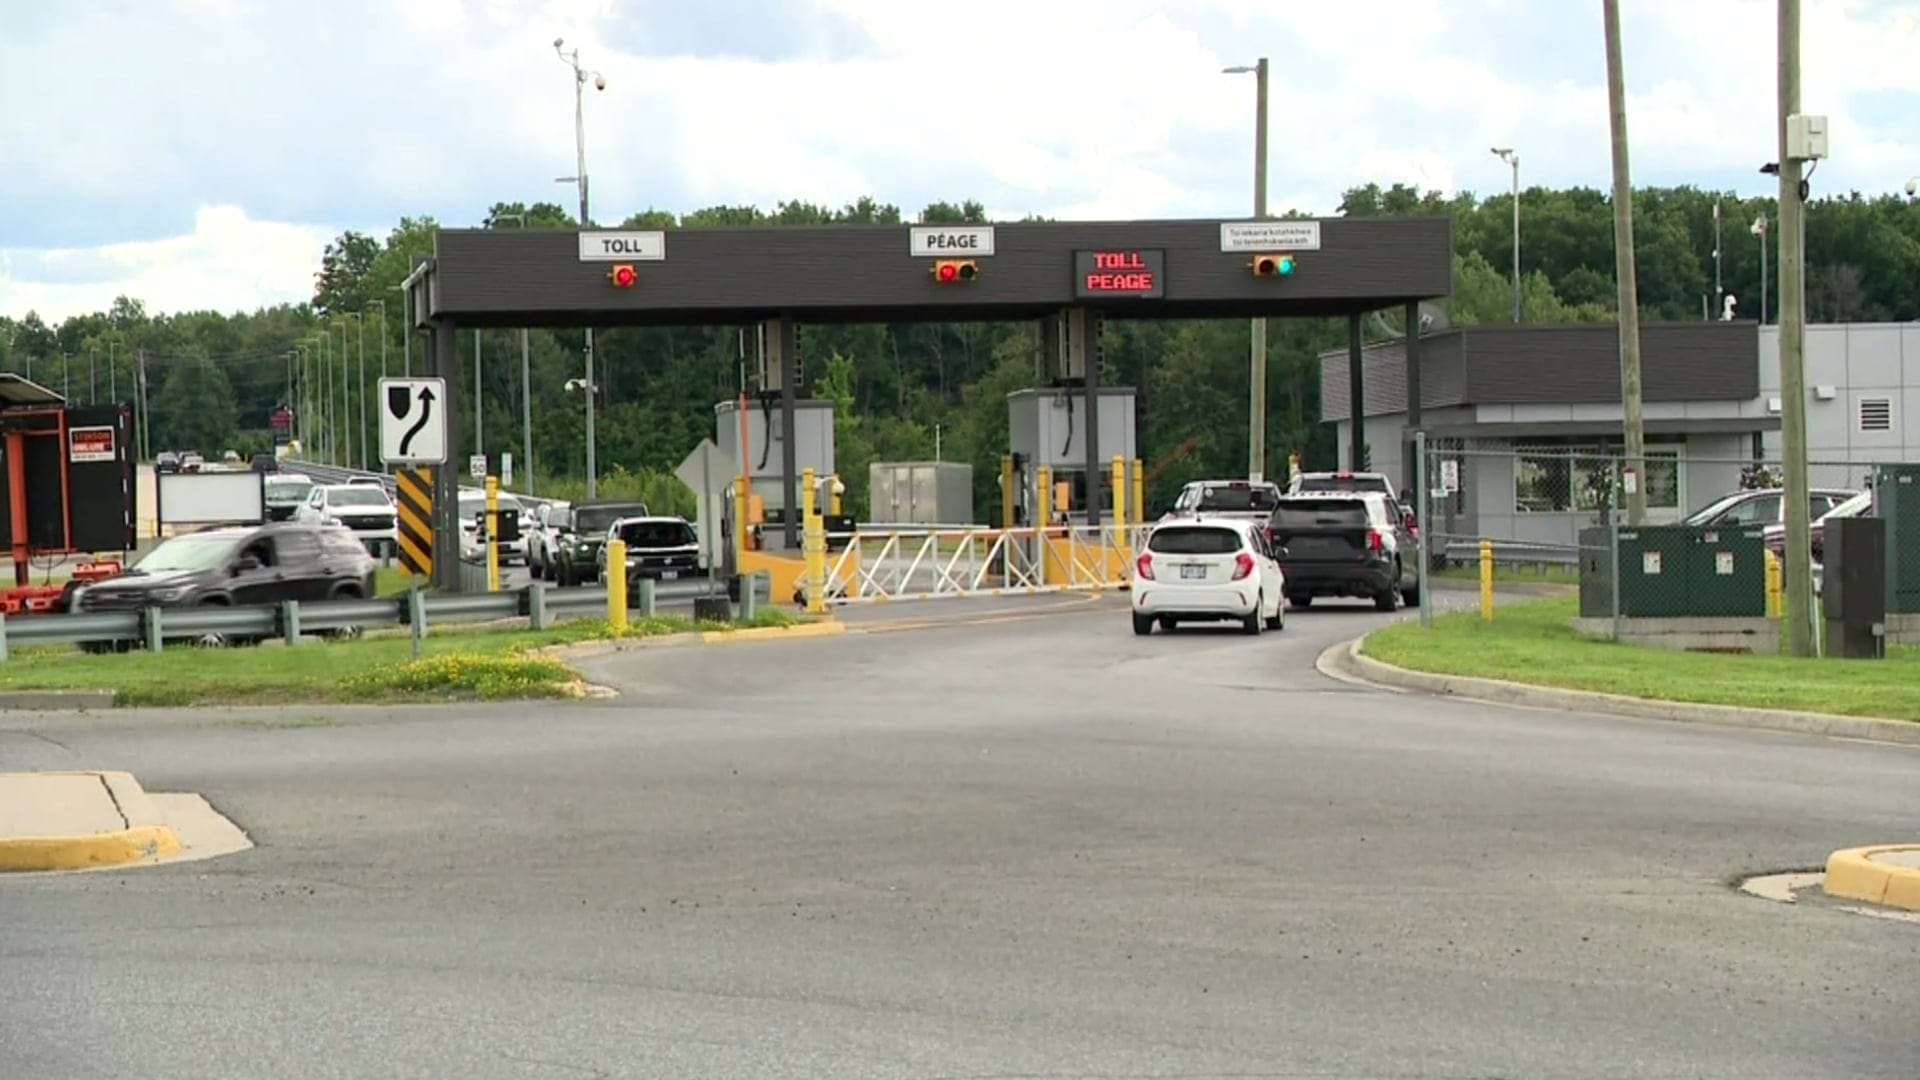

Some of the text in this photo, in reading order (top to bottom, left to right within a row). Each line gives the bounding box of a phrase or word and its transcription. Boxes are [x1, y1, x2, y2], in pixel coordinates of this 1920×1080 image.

[602, 239, 642, 253] TOLL
[927, 232, 978, 248] PÉAGE
[1094, 253, 1145, 268] TOLL
[1087, 274, 1152, 289] PEAGE
[472, 464, 485, 473] 50
